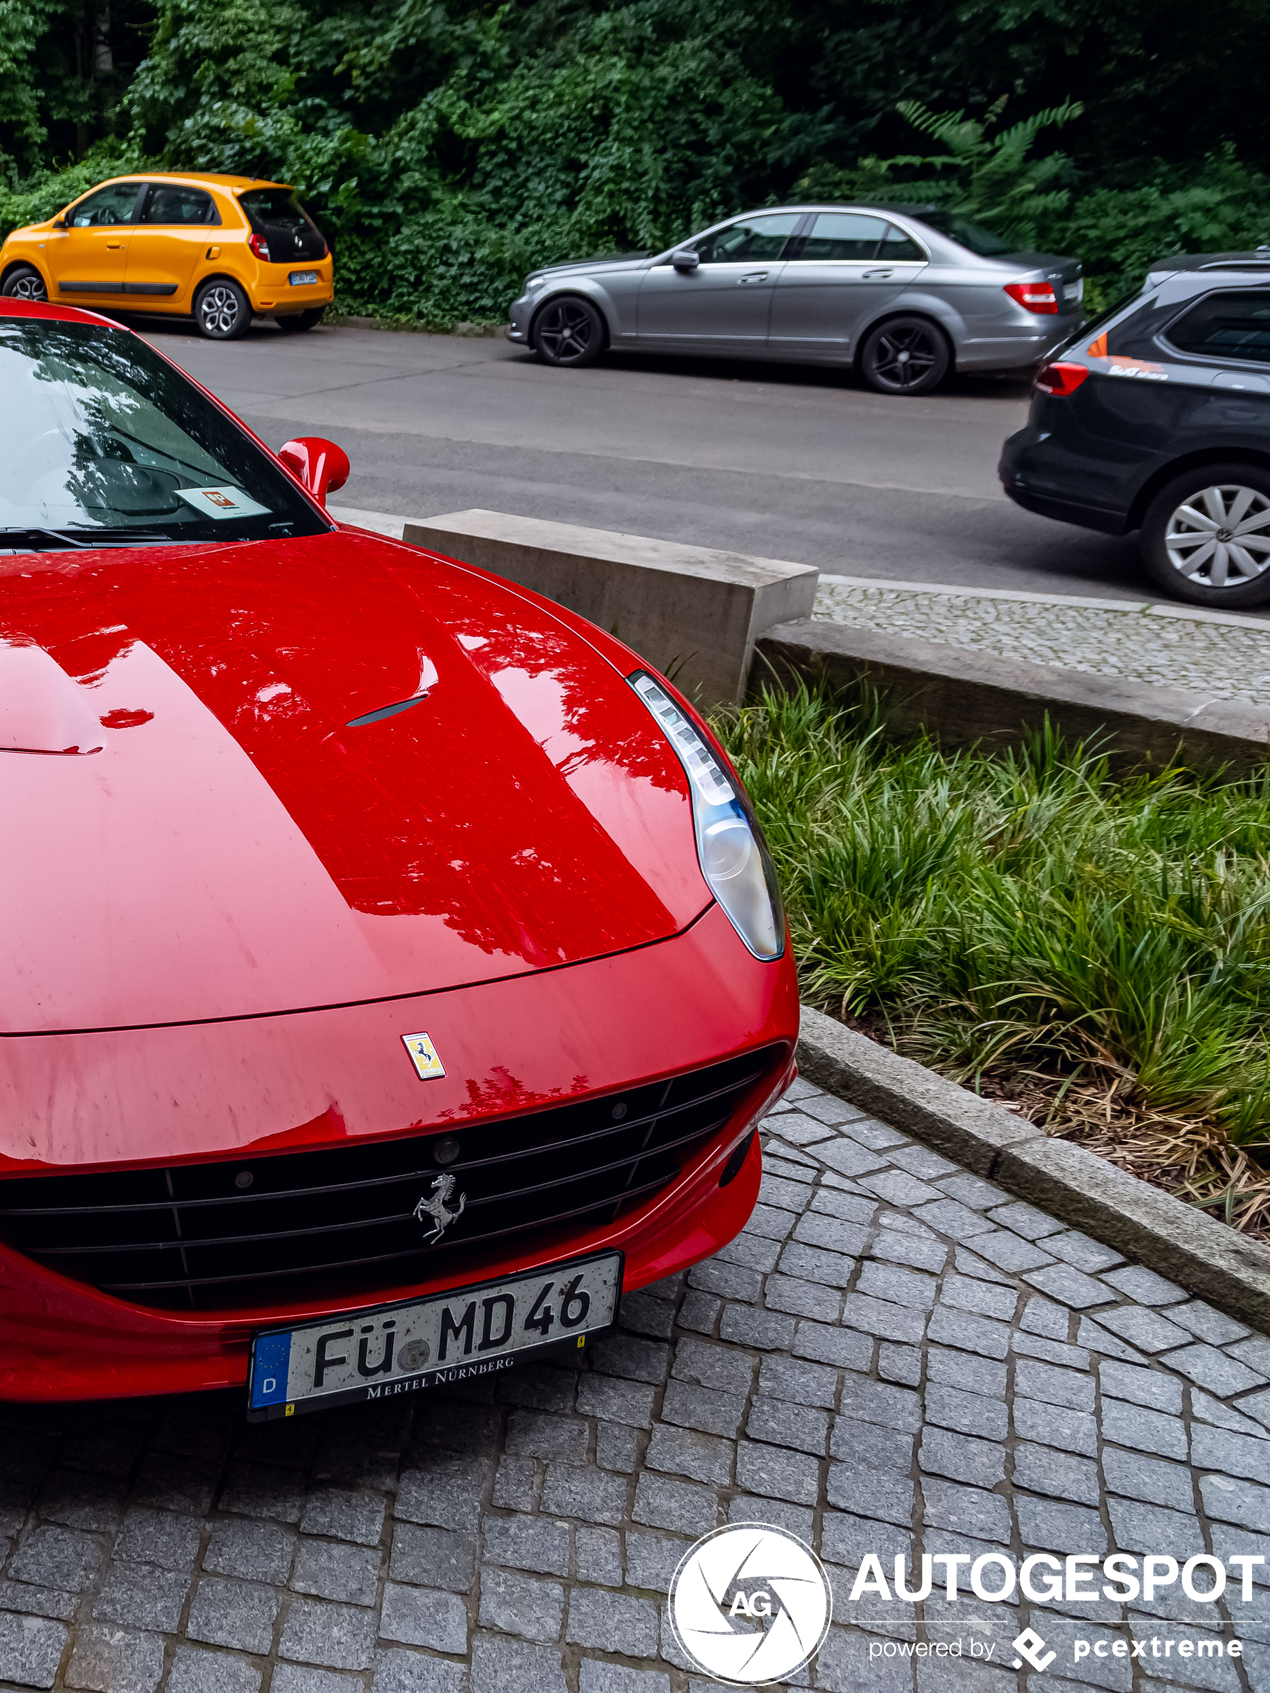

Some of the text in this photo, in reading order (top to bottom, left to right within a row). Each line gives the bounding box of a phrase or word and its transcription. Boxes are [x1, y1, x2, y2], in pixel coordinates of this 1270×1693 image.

[313, 1319, 397, 1388] FÜ
[437, 1292, 515, 1361] MD
[523, 1273, 591, 1335] 46
[262, 1377, 277, 1394] D
